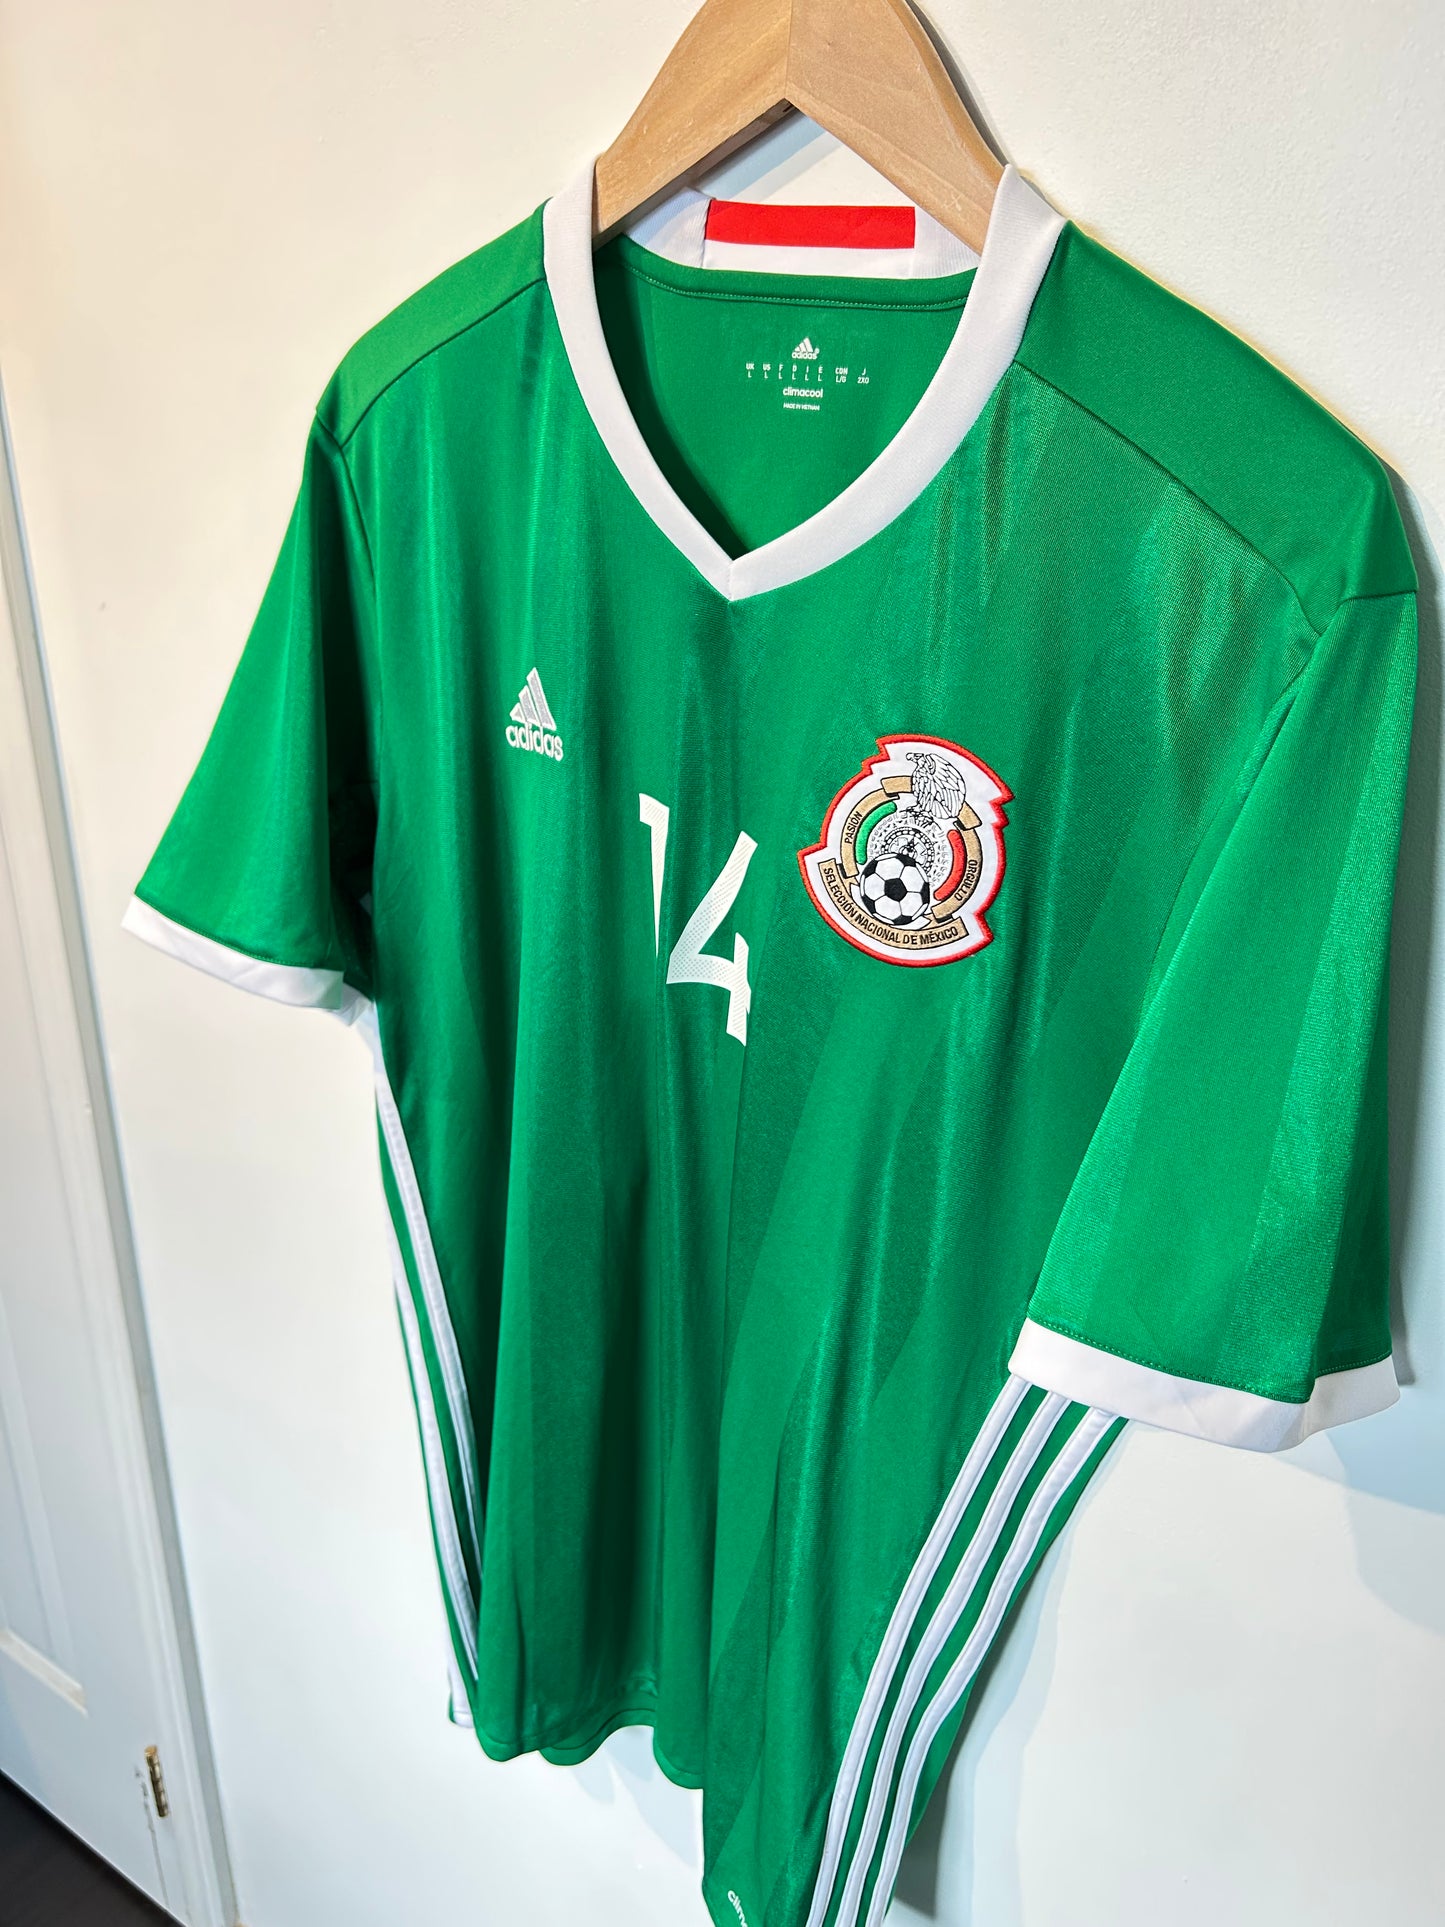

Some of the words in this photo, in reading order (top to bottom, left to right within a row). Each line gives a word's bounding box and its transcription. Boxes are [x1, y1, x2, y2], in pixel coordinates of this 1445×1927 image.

[763, 363, 771, 371] US
[818, 366, 823, 374] E
[835, 367, 848, 375] CDN
[862, 368, 866, 376] J
[791, 352, 818, 360] adidas
[783, 387, 823, 398] climacool
[505, 722, 563, 762] adidas
[954, 859, 978, 902] ORGULLO
[639, 792, 758, 1047] 14
[823, 867, 858, 918] SELECCIÓN
[855, 913, 901, 944] NACIONAL
[902, 934, 918, 945] DE
[920, 926, 958, 945] MÉXICO
